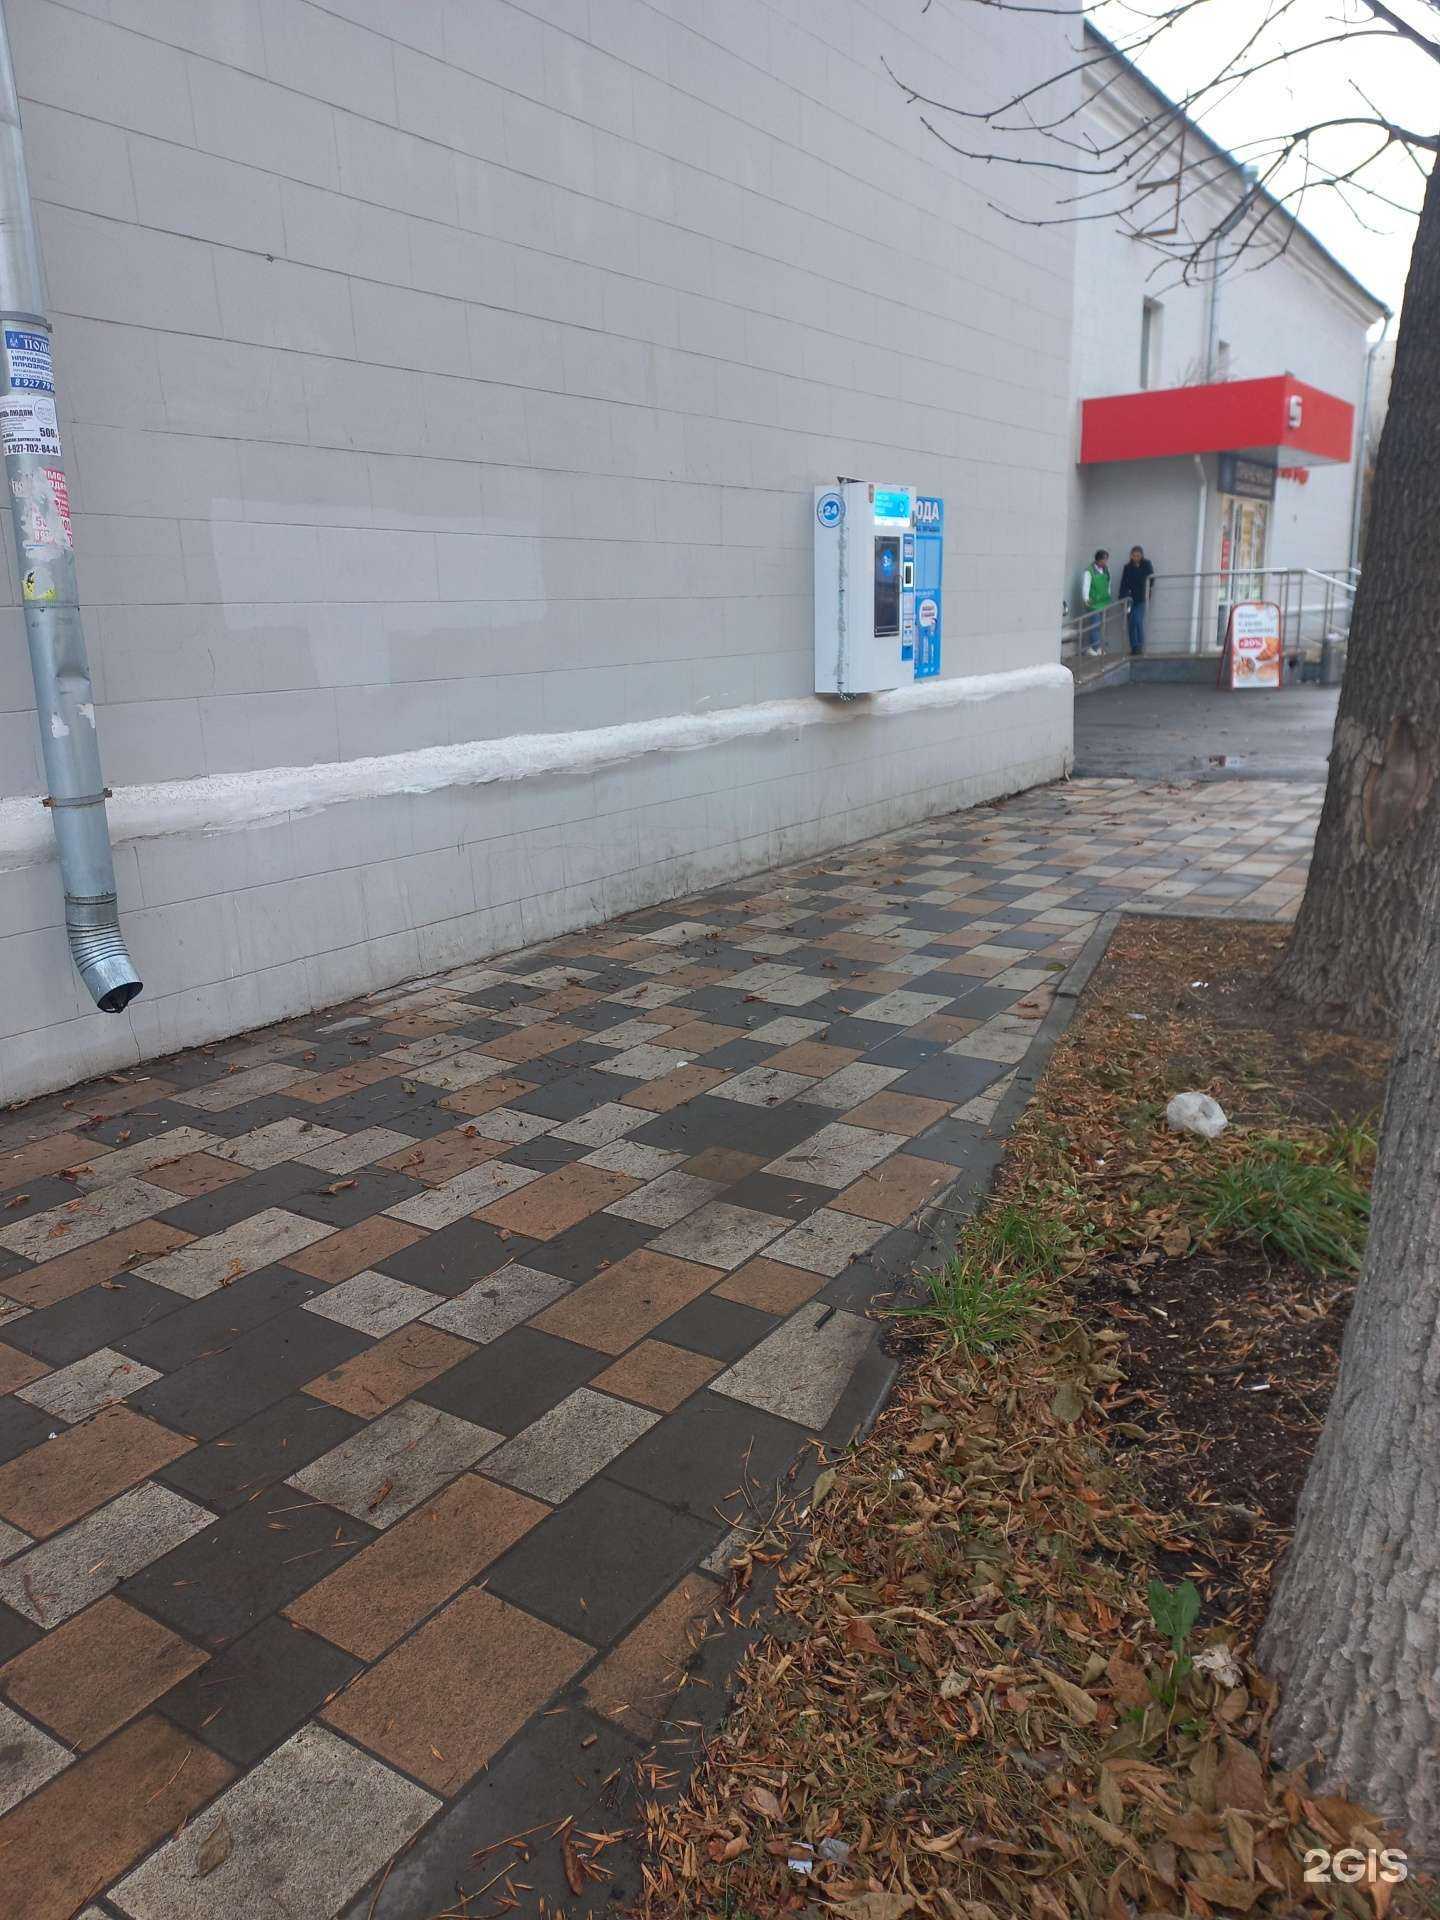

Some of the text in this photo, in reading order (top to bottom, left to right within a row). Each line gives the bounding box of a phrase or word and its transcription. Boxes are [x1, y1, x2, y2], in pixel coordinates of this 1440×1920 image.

[15, 378, 20, 386] 8
[23, 379, 40, 388] 927
[1290, 395, 1303, 427] 5
[824, 505, 837, 515] 24
[917, 500, 940, 522] ОДА
